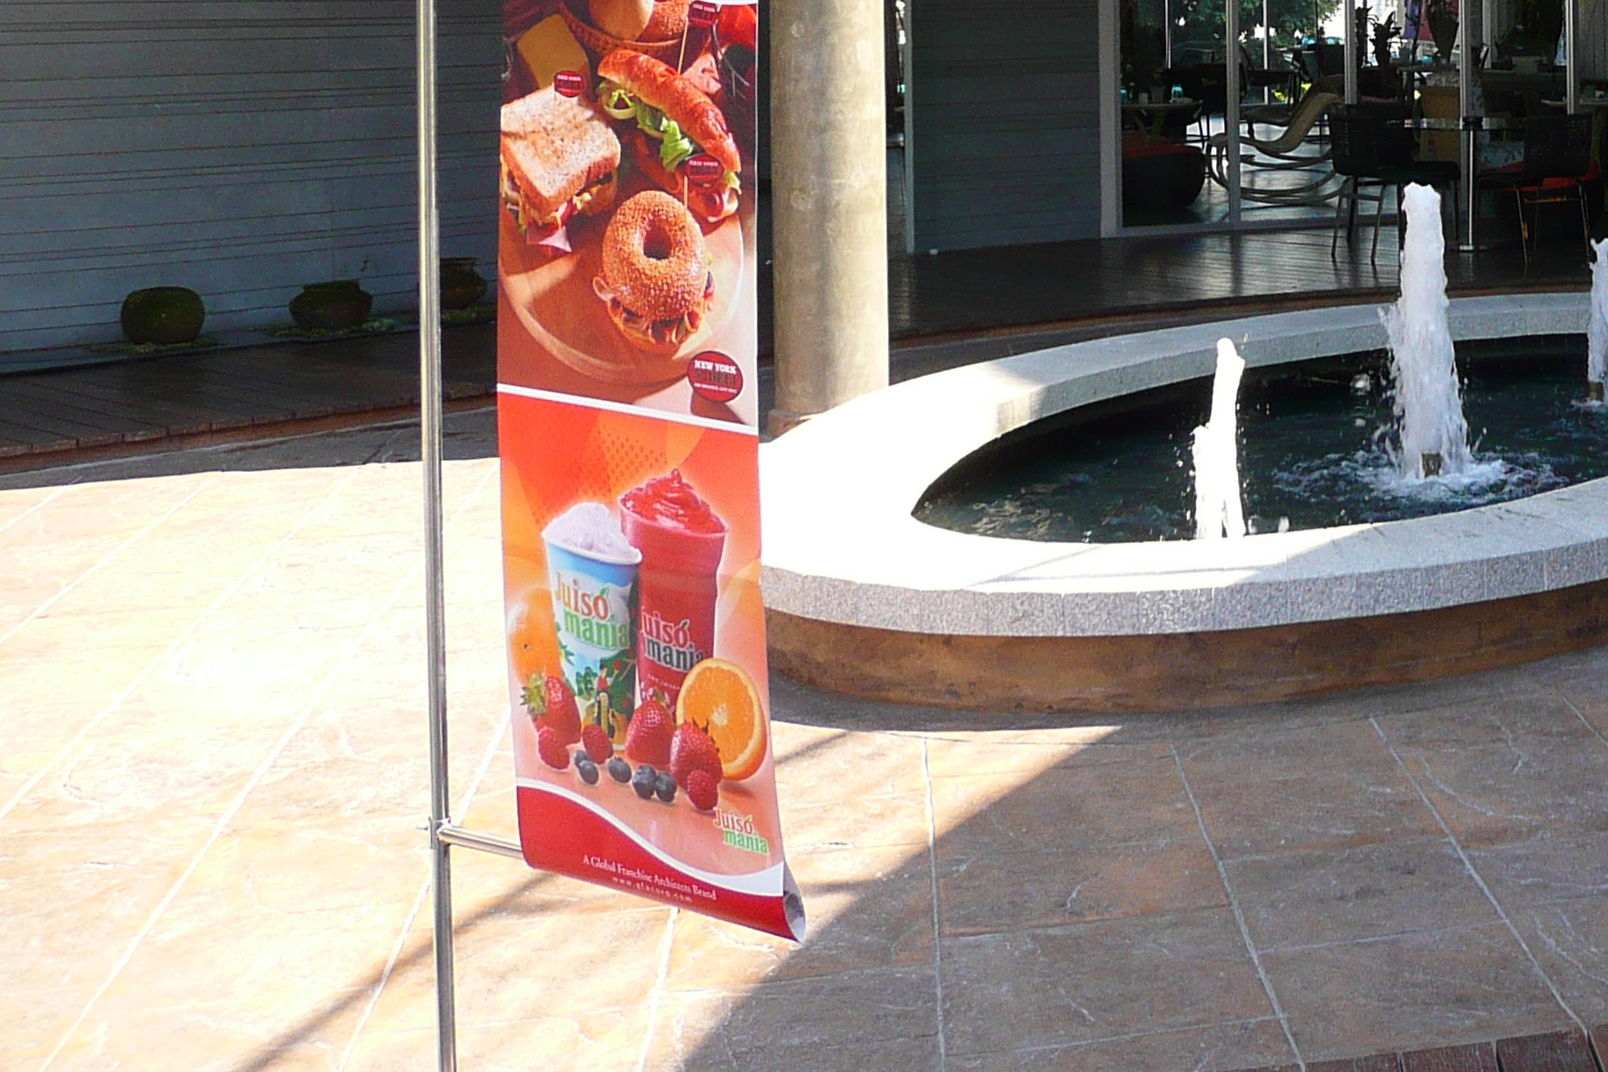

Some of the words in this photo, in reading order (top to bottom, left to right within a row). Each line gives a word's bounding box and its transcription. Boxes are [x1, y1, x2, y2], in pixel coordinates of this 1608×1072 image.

[693, 359, 714, 371] NEW
[714, 362, 738, 375] YORK
[564, 610, 630, 649] mania
[723, 829, 769, 855] mania
[582, 853, 591, 866] A
[591, 855, 617, 873] Global
[617, 862, 654, 883] Franchise
[692, 884, 718, 901] Brand
